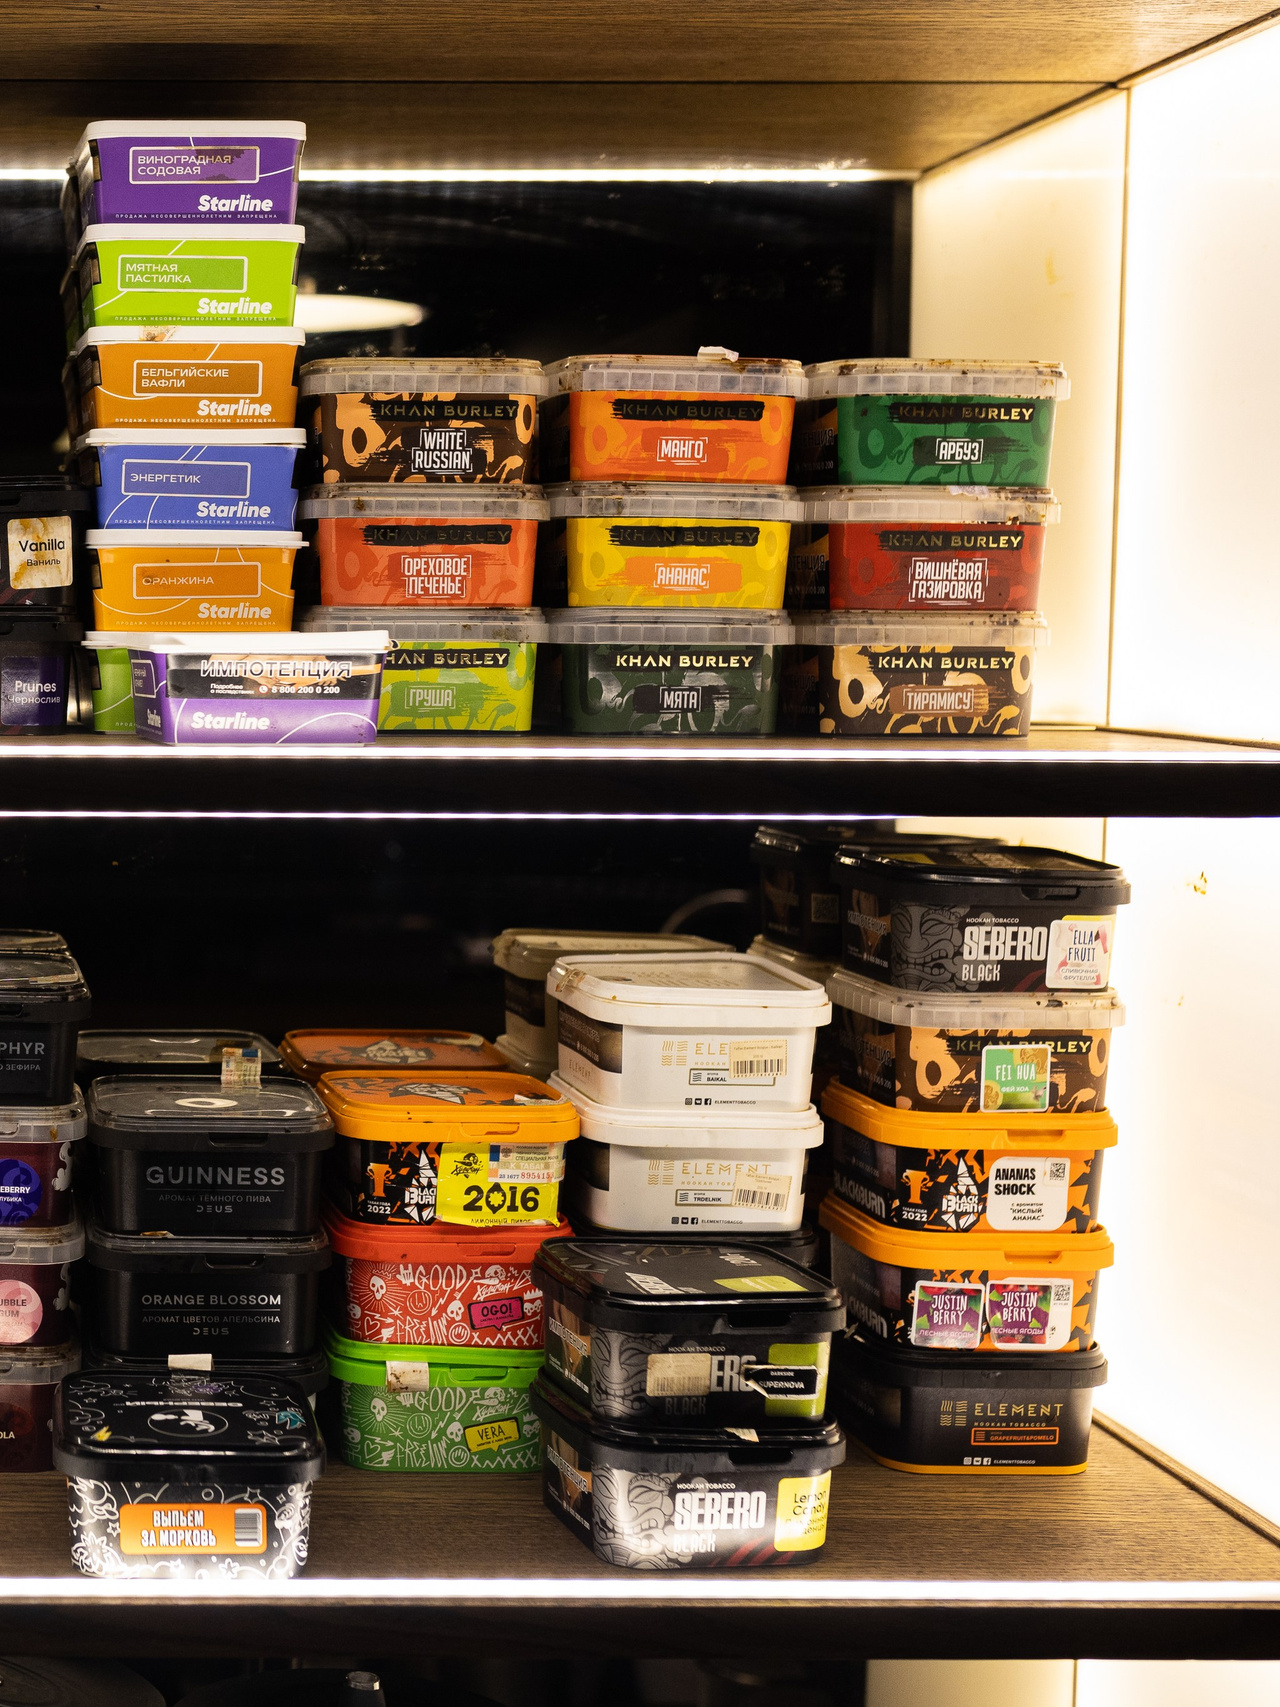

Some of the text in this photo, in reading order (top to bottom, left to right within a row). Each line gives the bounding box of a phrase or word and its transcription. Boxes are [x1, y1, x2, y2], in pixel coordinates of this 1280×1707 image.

[138, 155, 231, 165] ВИНОГРАДНАЯ
[138, 166, 201, 176] СОДОВАЯ
[198, 194, 272, 212] Starline
[126, 263, 178, 272] МЯТНАЯ
[126, 274, 191, 283] ПАСТИЛКА
[197, 297, 272, 314] Starline
[142, 367, 229, 377] БЕЛЬГИЙСКИЕ
[142, 379, 185, 388] ВАФЛИ
[380, 404, 518, 417] KHAN BURLEY
[424, 432, 463, 449] WHITE
[661, 439, 704, 458] МАНГО
[939, 441, 979, 461] АРБУЗ
[415, 451, 470, 469] RUSSIAN
[130, 473, 200, 483] ЭНЕРГЕТИК
[197, 501, 270, 518] Starline
[19, 538, 65, 552] Vanilla
[27, 558, 61, 567] Ваниль
[404, 558, 467, 575] ОРЕХОВОЕ
[916, 558, 982, 581] ВИШНЁВАЯ
[142, 576, 214, 585] ОРАНЖИНА
[658, 566, 707, 585] АНАНАС
[409, 578, 462, 595] ПЕЧЕНЬЕ
[912, 579, 982, 599] ГАЗИРОВКА
[616, 655, 753, 667] KHAN BURLEY
[200, 660, 352, 679] ИМПОТЕНЦИЯ
[15, 680, 56, 692] Prunes
[8, 695, 60, 704] Чернослив
[410, 689, 452, 707] ГРУША
[664, 691, 697, 709] МЯТА
[907, 691, 971, 709] ТИРАМИСУ
[963, 926, 1048, 961] SEBERO
[1074, 930, 1093, 945] ELLA
[1068, 948, 1096, 961] FRUIT
[996, 1064, 1035, 1081] FEI HUA
[146, 1167, 285, 1185] GUINNESS
[995, 1168, 1036, 1181] ANANAS
[995, 1183, 1035, 1196] SHOCK
[463, 1182, 540, 1214] 2016
[142, 1295, 281, 1305] ORANGE BLOSSOM
[932, 1295, 967, 1311] JUSTIN
[481, 1303, 513, 1317] OGO!
[933, 1309, 964, 1325] BERRY
[759, 1381, 804, 1389] SUPERNOVA
[975, 1403, 1063, 1416] ELEMENT
[477, 1425, 505, 1441] VERA
[154, 1510, 204, 1527] ВЫПЬЕМ
[141, 1530, 216, 1546] ЗА МОРКОВЬ
